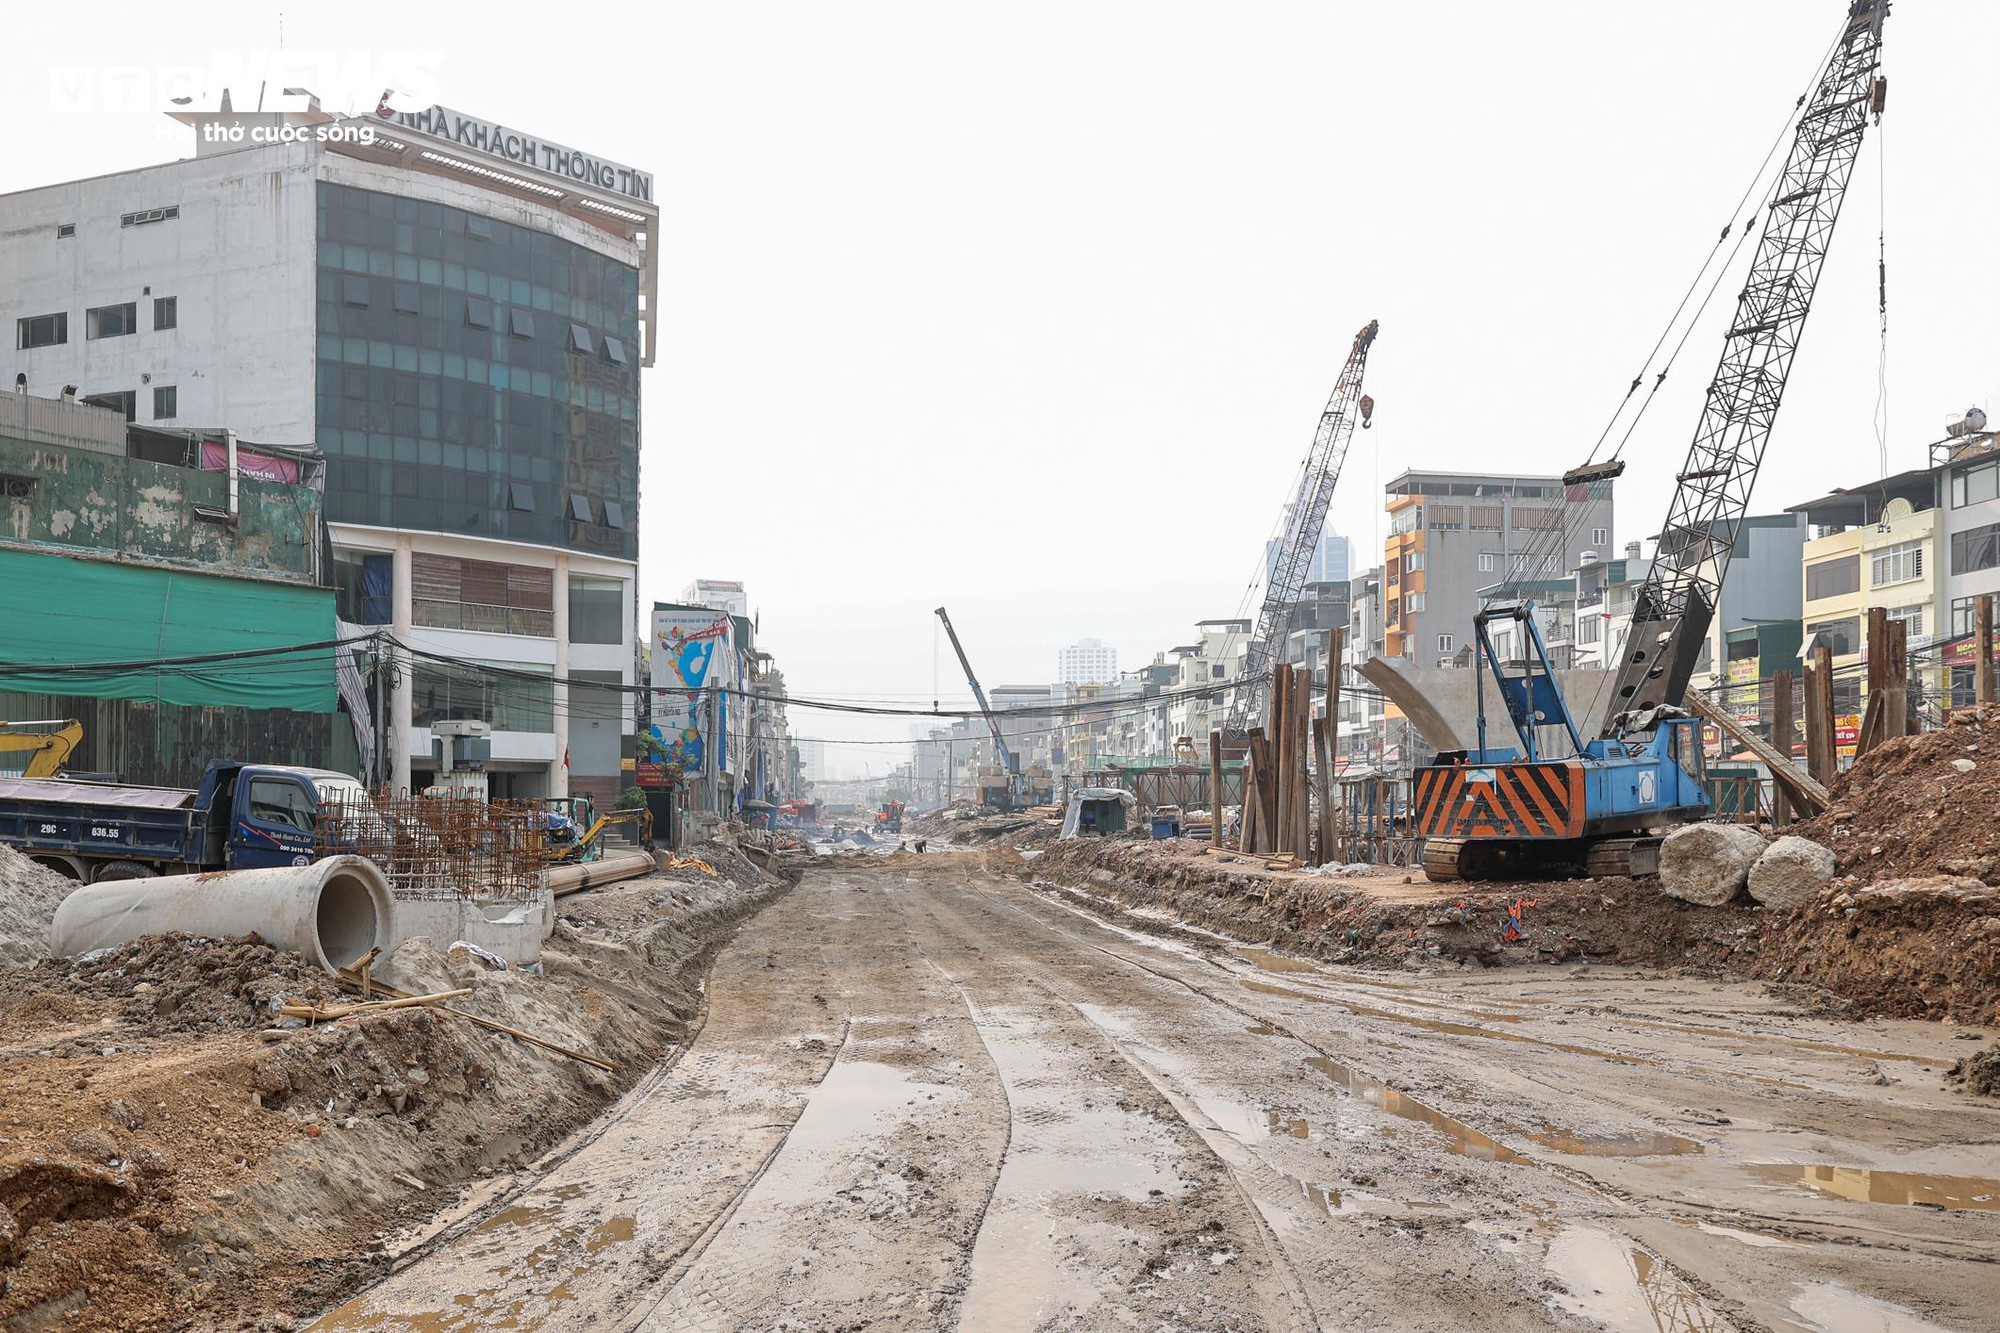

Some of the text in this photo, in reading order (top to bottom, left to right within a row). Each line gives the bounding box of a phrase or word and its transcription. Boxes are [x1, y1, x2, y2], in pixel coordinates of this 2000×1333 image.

[401, 106, 450, 139] NHÀ
[456, 117, 536, 166] KHÁCH
[541, 145, 615, 189] THÔNG
[40, 824, 57, 834] 29C
[91, 827, 119, 838] 636.55
